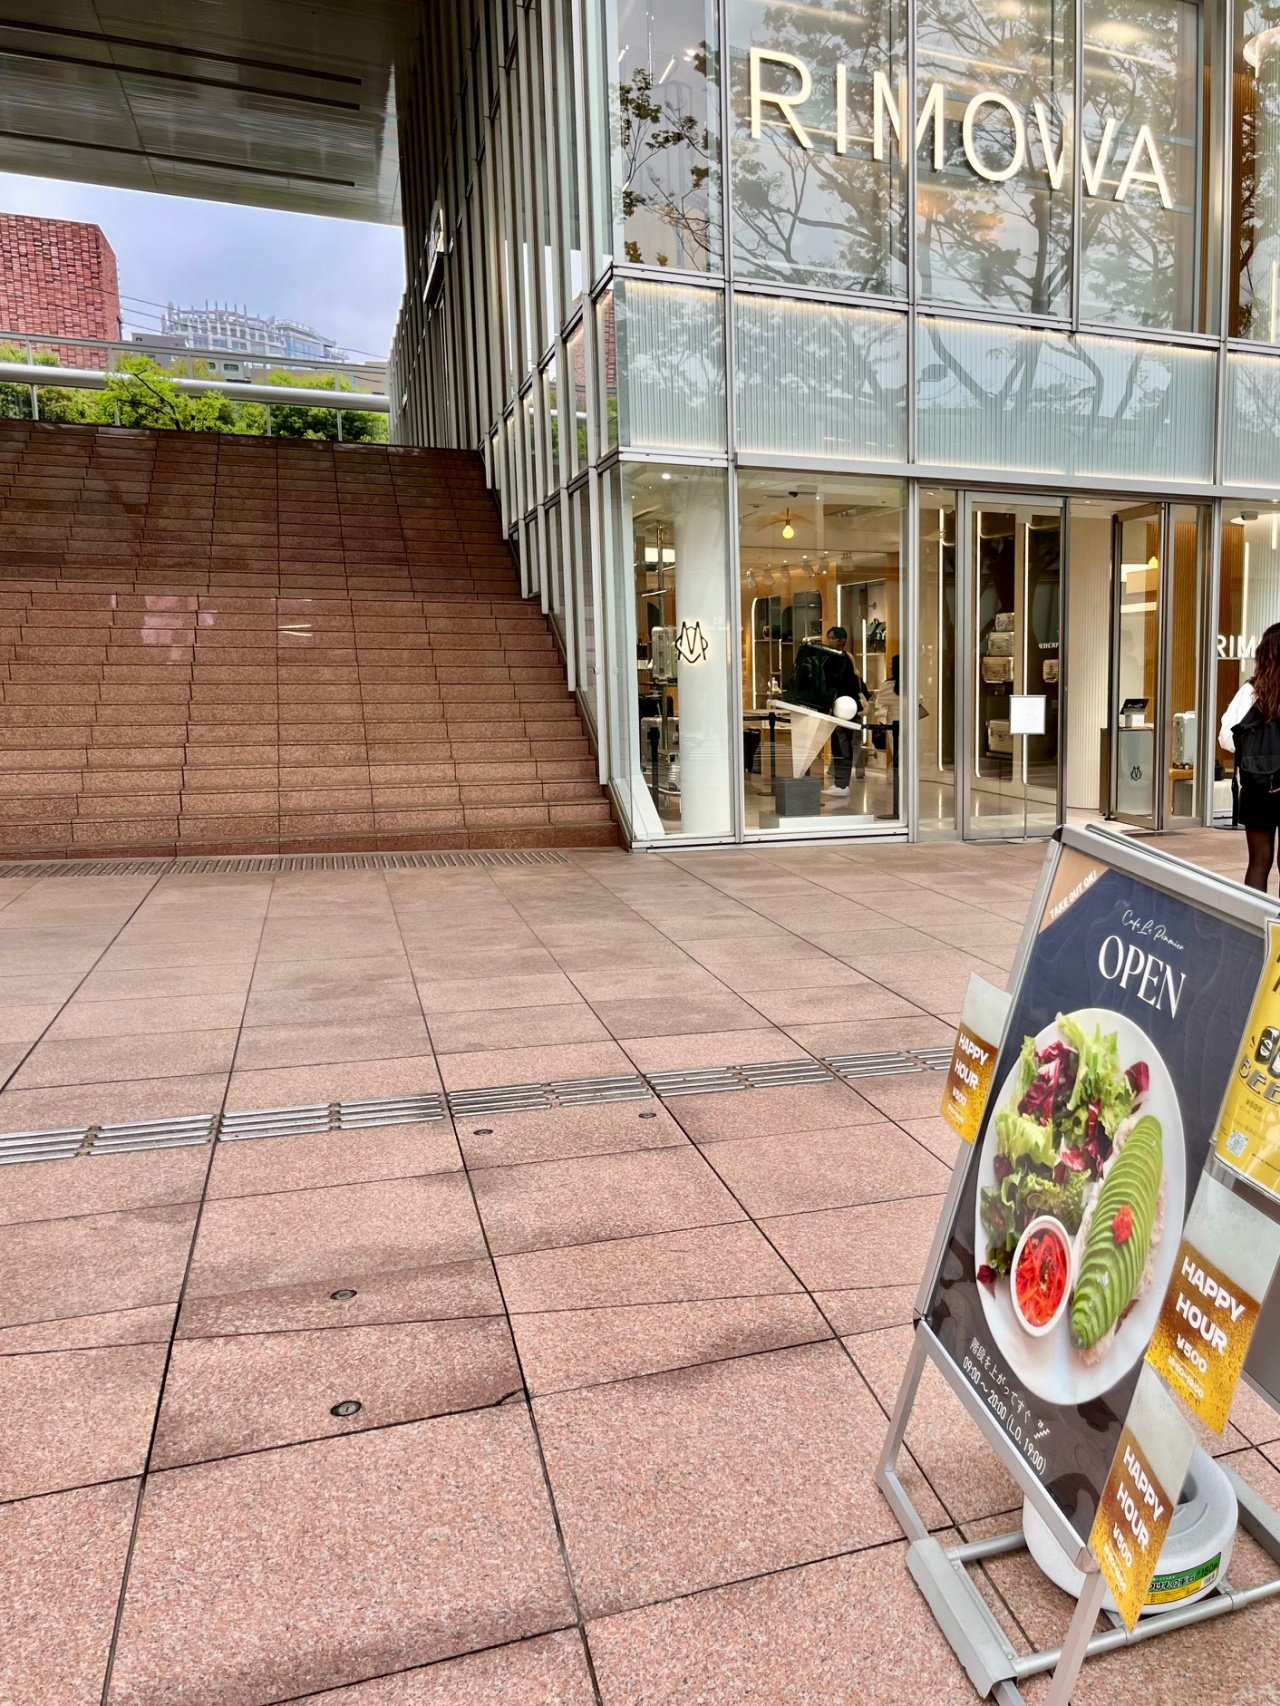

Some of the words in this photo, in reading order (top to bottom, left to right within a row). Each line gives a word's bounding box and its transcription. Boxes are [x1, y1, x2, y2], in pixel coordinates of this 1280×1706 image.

[749, 46, 1175, 209] RIMOWA
[1217, 635, 1262, 658] RIM
[1049, 897, 1069, 920] TAKE
[1068, 882, 1084, 903] OUT
[1083, 870, 1097, 888] OK!
[1099, 935, 1186, 1019] OPEN
[954, 1058, 979, 1090] HOUR
[958, 1032, 989, 1066] HAPPY
[1246, 1098, 1263, 1113] ¥500
[1181, 1255, 1245, 1323] HAPPY
[1175, 1291, 1228, 1355] HOUR
[1176, 1333, 1208, 1373] ¥500
[970, 1337, 1031, 1423] 階段を上がってすぐ
[963, 1356, 981, 1384] 09:00
[987, 1390, 1007, 1420] 20:00
[1023, 1438, 1047, 1475] 19:00)
[1123, 1444, 1164, 1522] HAPPY
[1112, 1522, 1132, 1567] ¥500
[1116, 1481, 1149, 1553] HOUR
